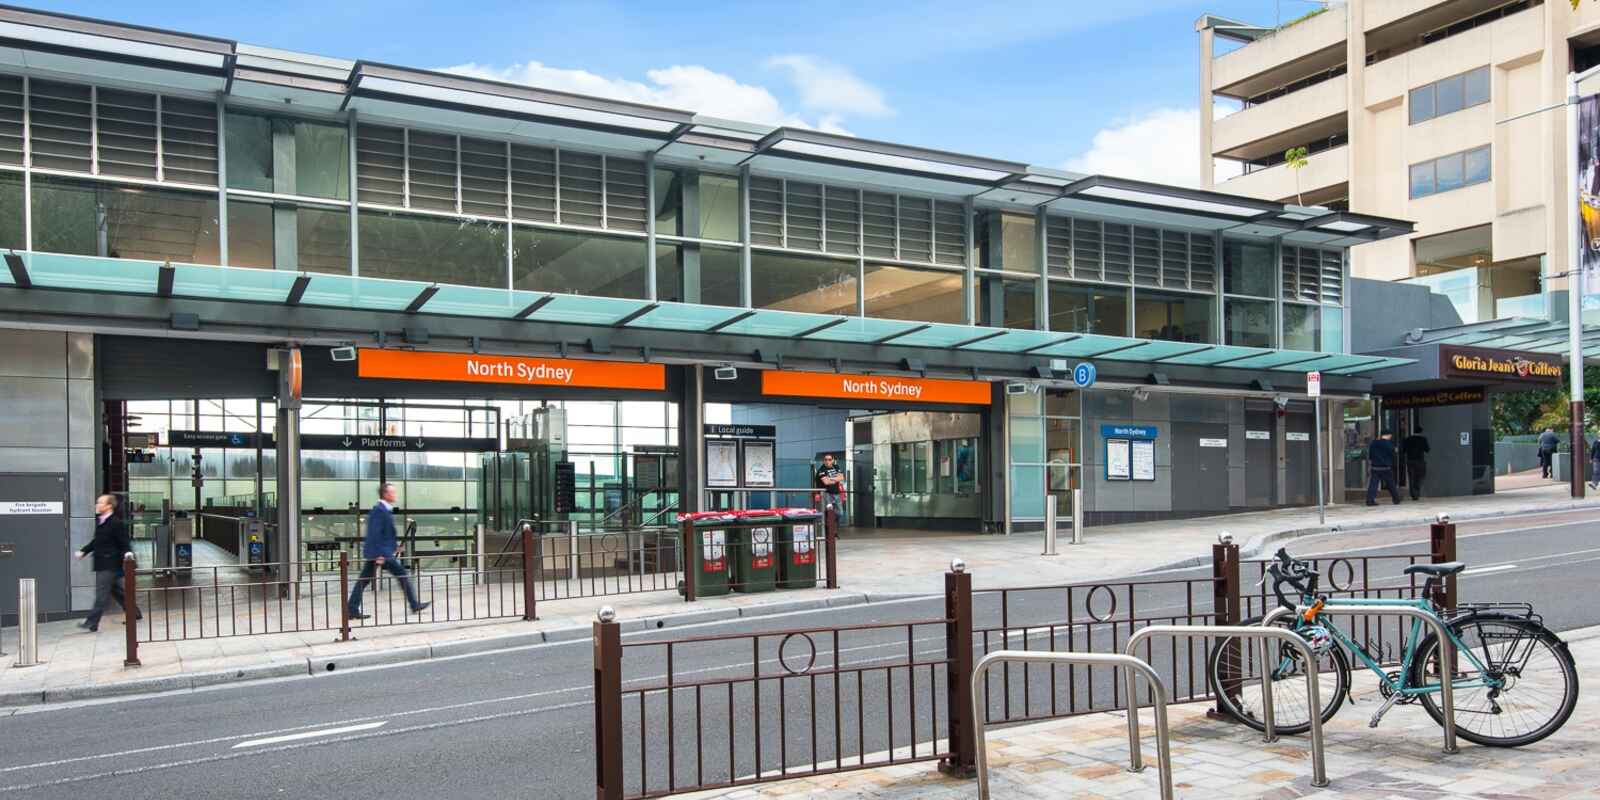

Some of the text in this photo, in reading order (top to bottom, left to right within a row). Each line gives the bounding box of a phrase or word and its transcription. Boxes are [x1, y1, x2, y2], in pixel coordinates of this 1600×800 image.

[1453, 354, 1488, 371] Gloria
[467, 360, 573, 383] North Sydney
[1078, 368, 1087, 382] B
[843, 379, 922, 398] North Sydney
[719, 425, 735, 433] Local
[361, 438, 407, 448] Platforms
